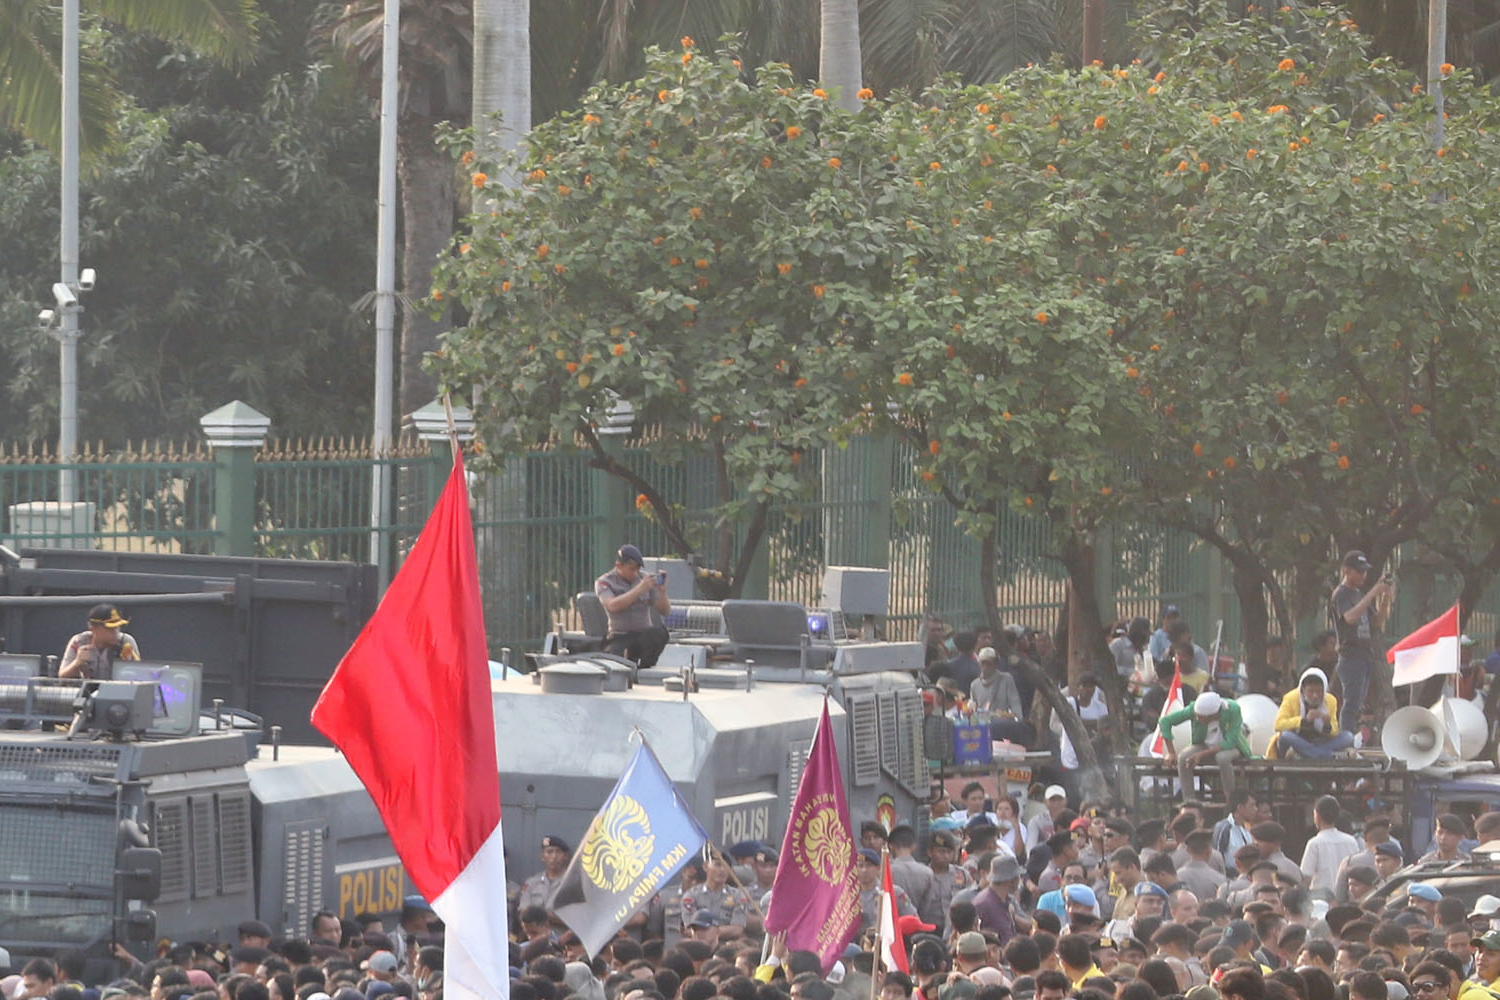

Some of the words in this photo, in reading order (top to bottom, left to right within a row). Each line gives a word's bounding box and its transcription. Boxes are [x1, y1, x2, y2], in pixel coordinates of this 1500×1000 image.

[722, 807, 769, 846] POLISI
[792, 830, 811, 878] IKATAN
[339, 865, 404, 919] POLISI
